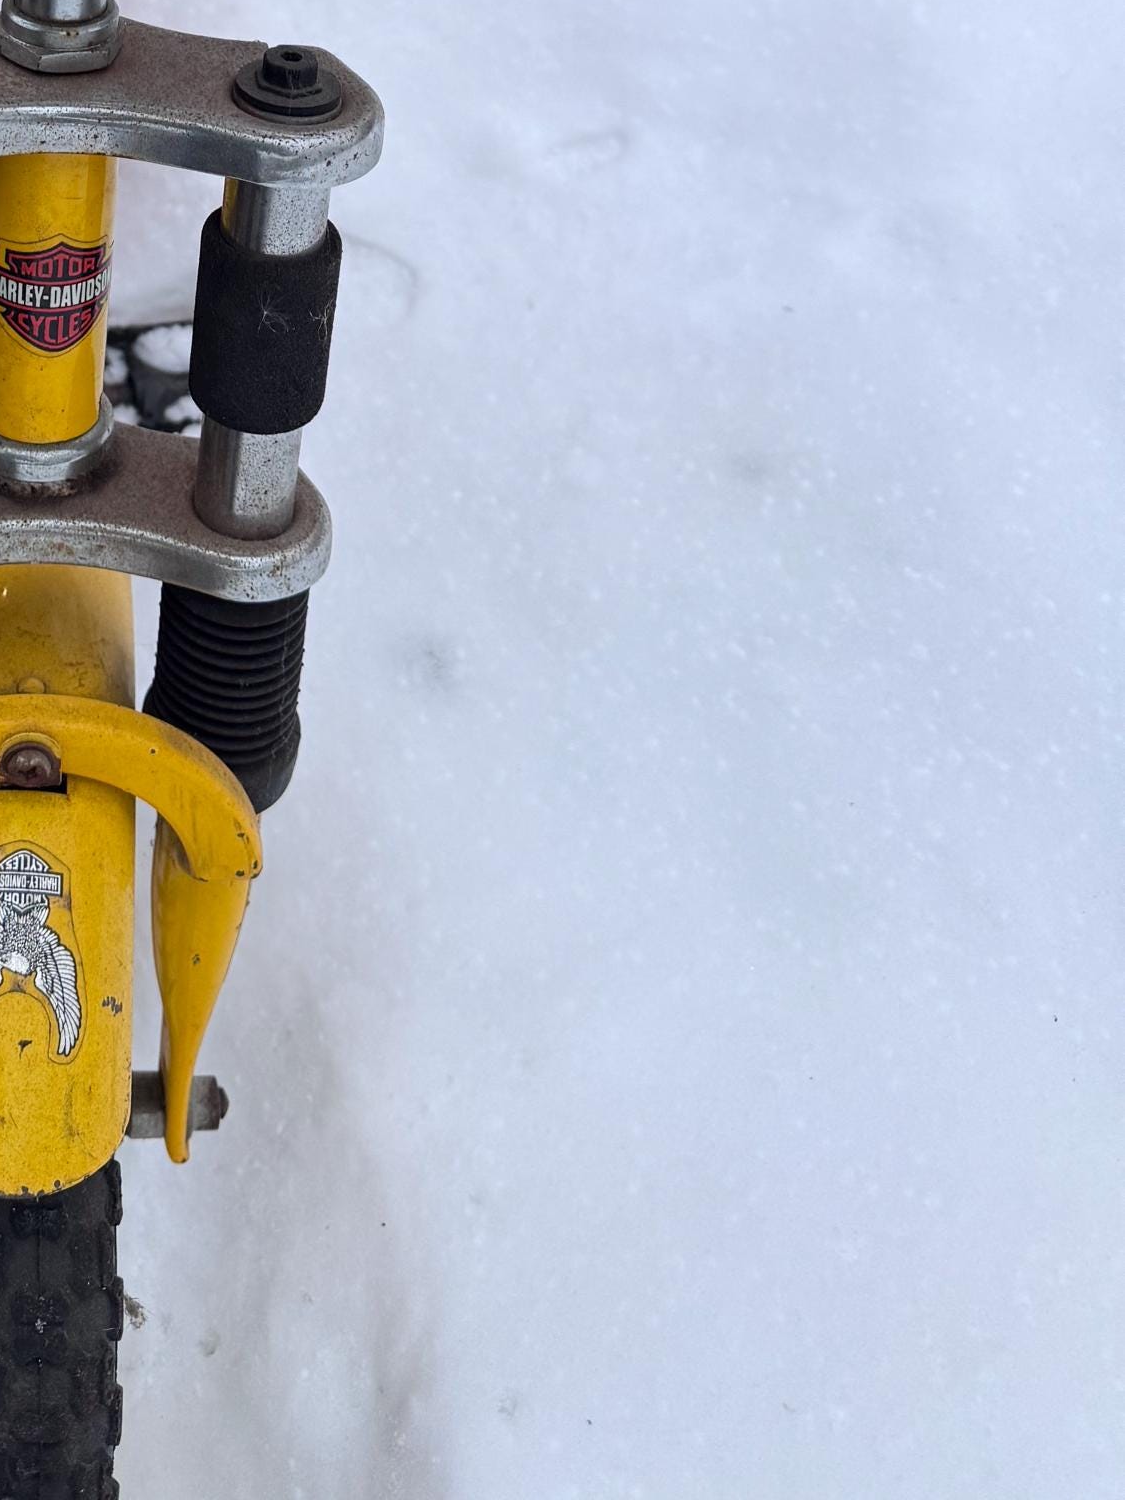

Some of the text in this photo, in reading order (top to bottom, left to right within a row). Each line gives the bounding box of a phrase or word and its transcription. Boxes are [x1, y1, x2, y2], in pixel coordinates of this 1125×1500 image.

[21, 254, 95, 277] MOTOR
[16, 308, 92, 344] CYCLES
[5, 854, 43, 872] CYCLES
[4, 892, 41, 907] MOTOR
